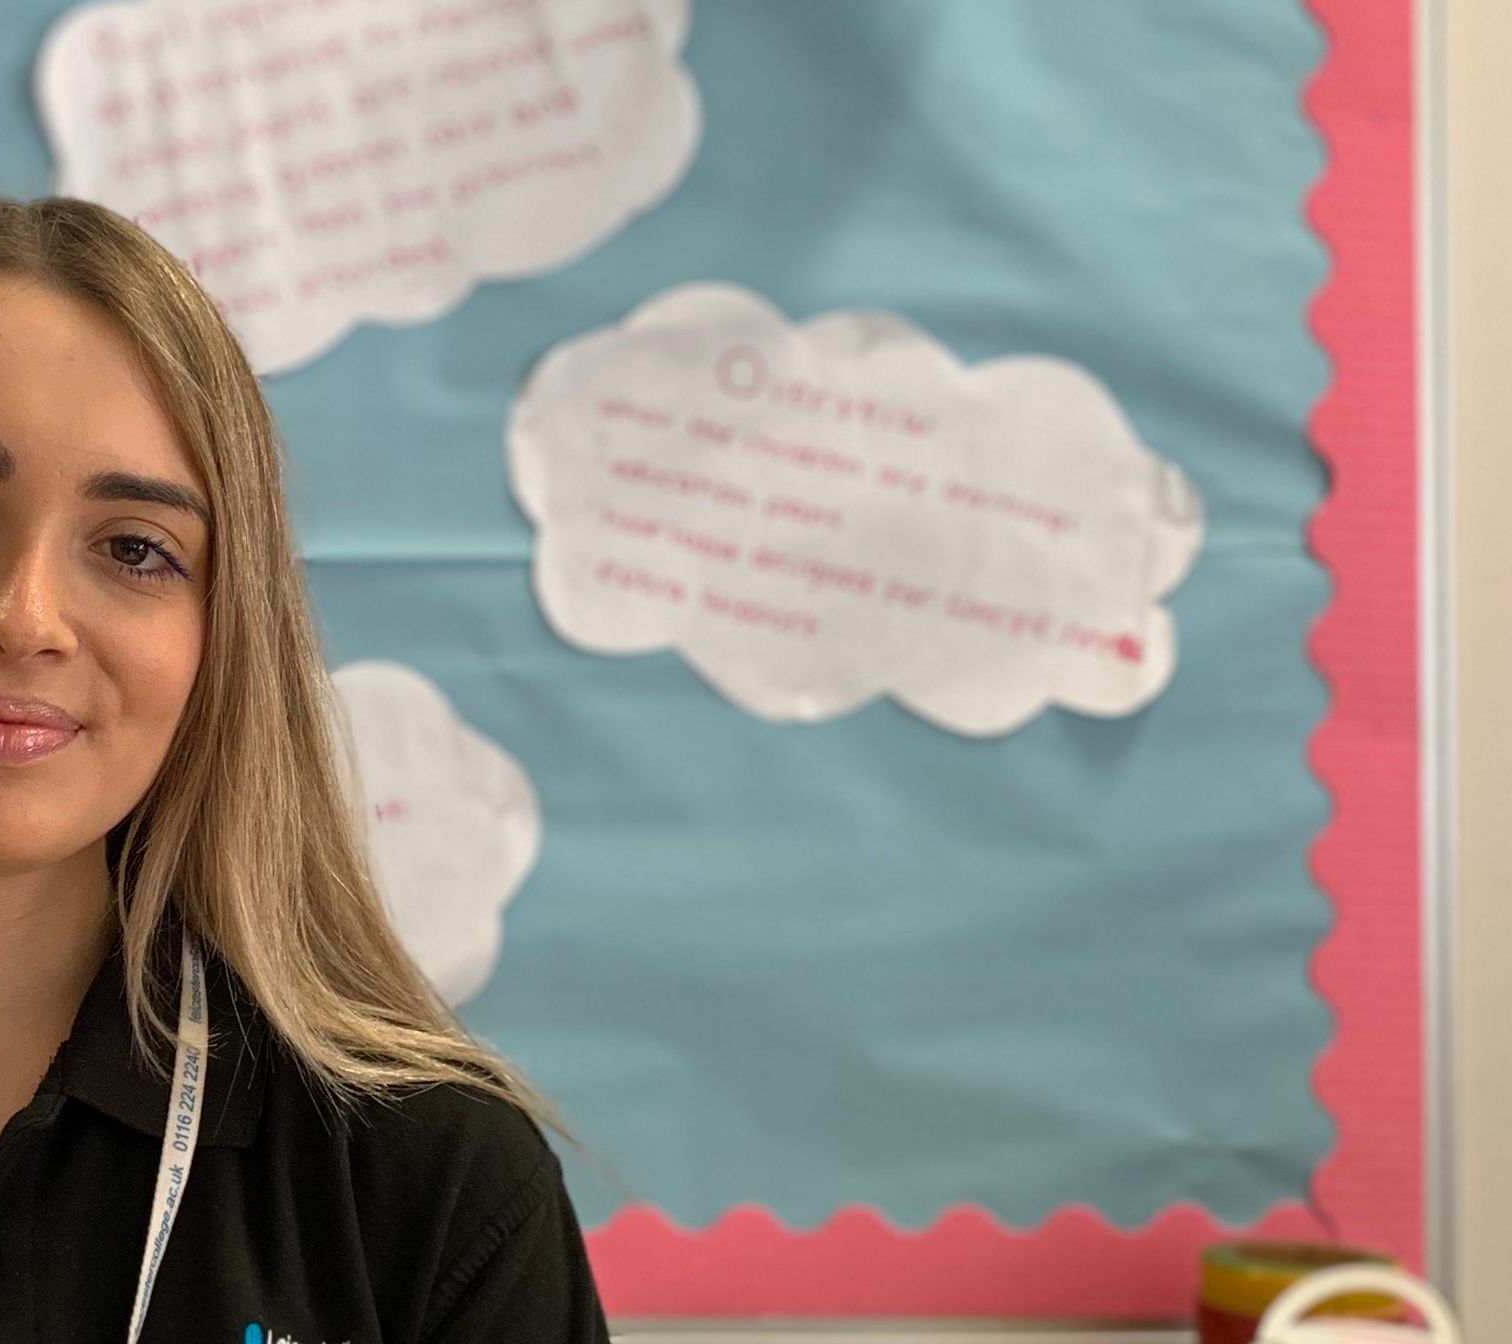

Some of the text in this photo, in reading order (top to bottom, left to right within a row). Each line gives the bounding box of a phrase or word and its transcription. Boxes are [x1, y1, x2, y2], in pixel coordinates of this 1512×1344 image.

[179, 1084, 196, 1112] 224
[172, 1114, 192, 1152] 0116
[135, 1164, 184, 1336] estercollege.ac.uk
